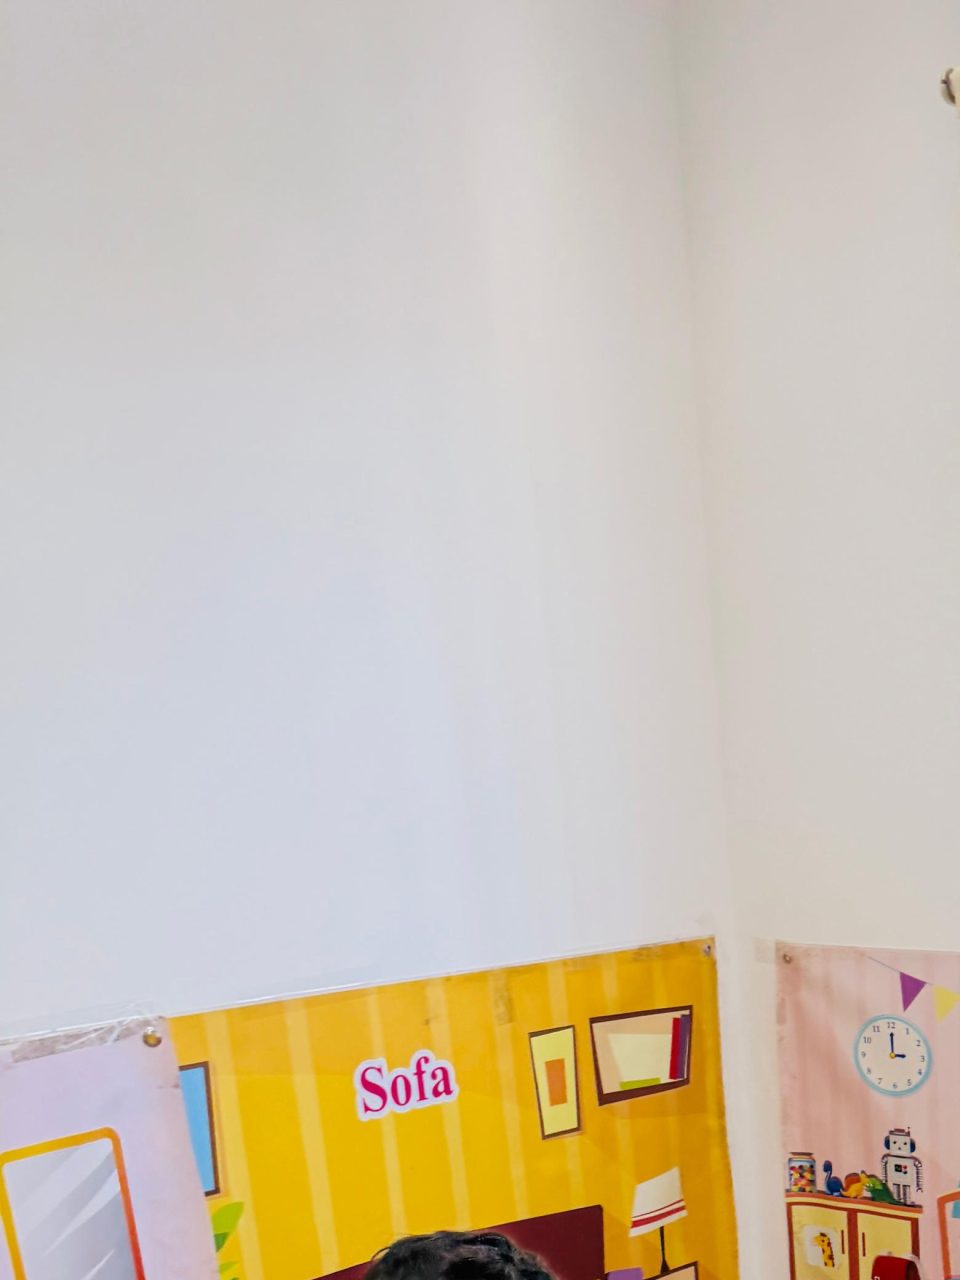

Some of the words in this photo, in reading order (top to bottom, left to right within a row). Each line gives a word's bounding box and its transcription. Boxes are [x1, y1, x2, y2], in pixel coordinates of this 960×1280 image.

[872, 1025, 880, 1033] 11
[887, 1021, 896, 1029] 12
[863, 1036, 872, 1044] 10
[360, 1055, 454, 1114] Sofa
